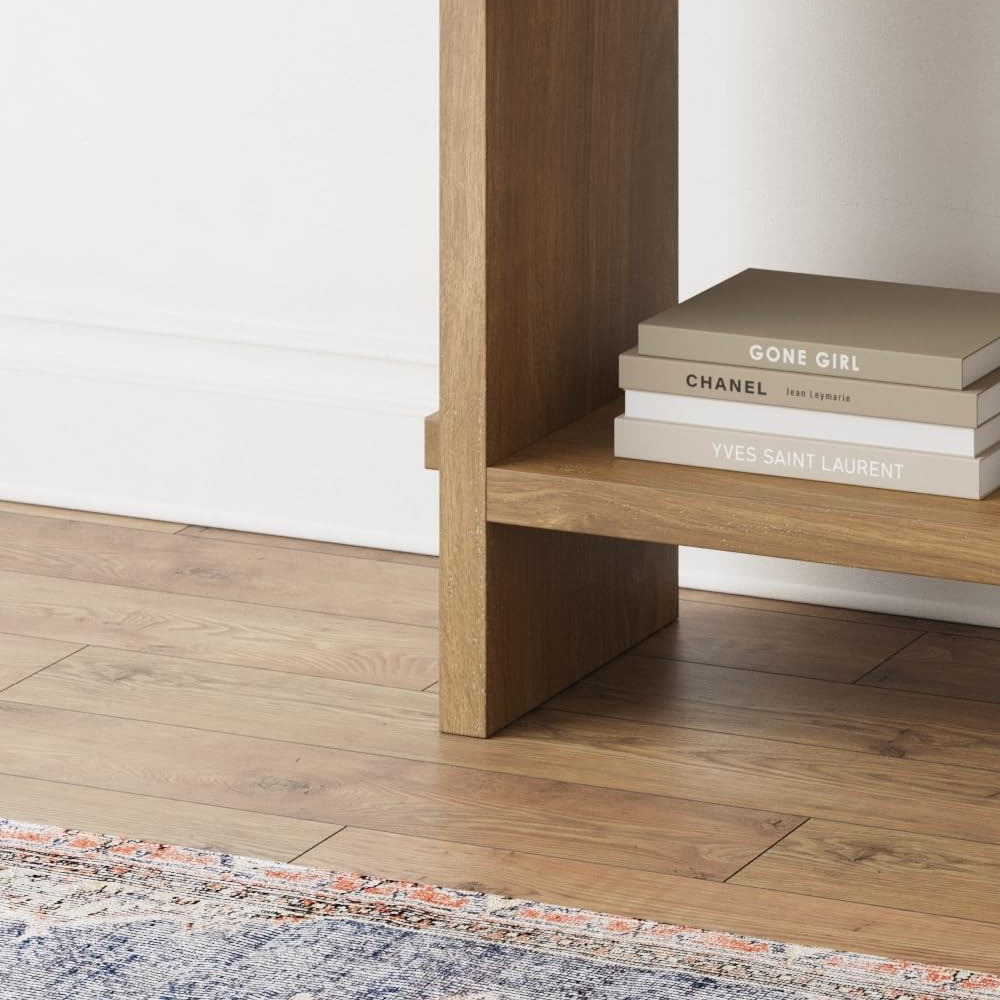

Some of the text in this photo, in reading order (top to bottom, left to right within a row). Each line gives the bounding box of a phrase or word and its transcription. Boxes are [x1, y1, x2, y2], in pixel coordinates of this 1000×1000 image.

[749, 344, 860, 371] GONE GIRL
[685, 373, 851, 403] CHANEL Jean Leymarie
[712, 441, 904, 480] YVES SAINT LAURENT
